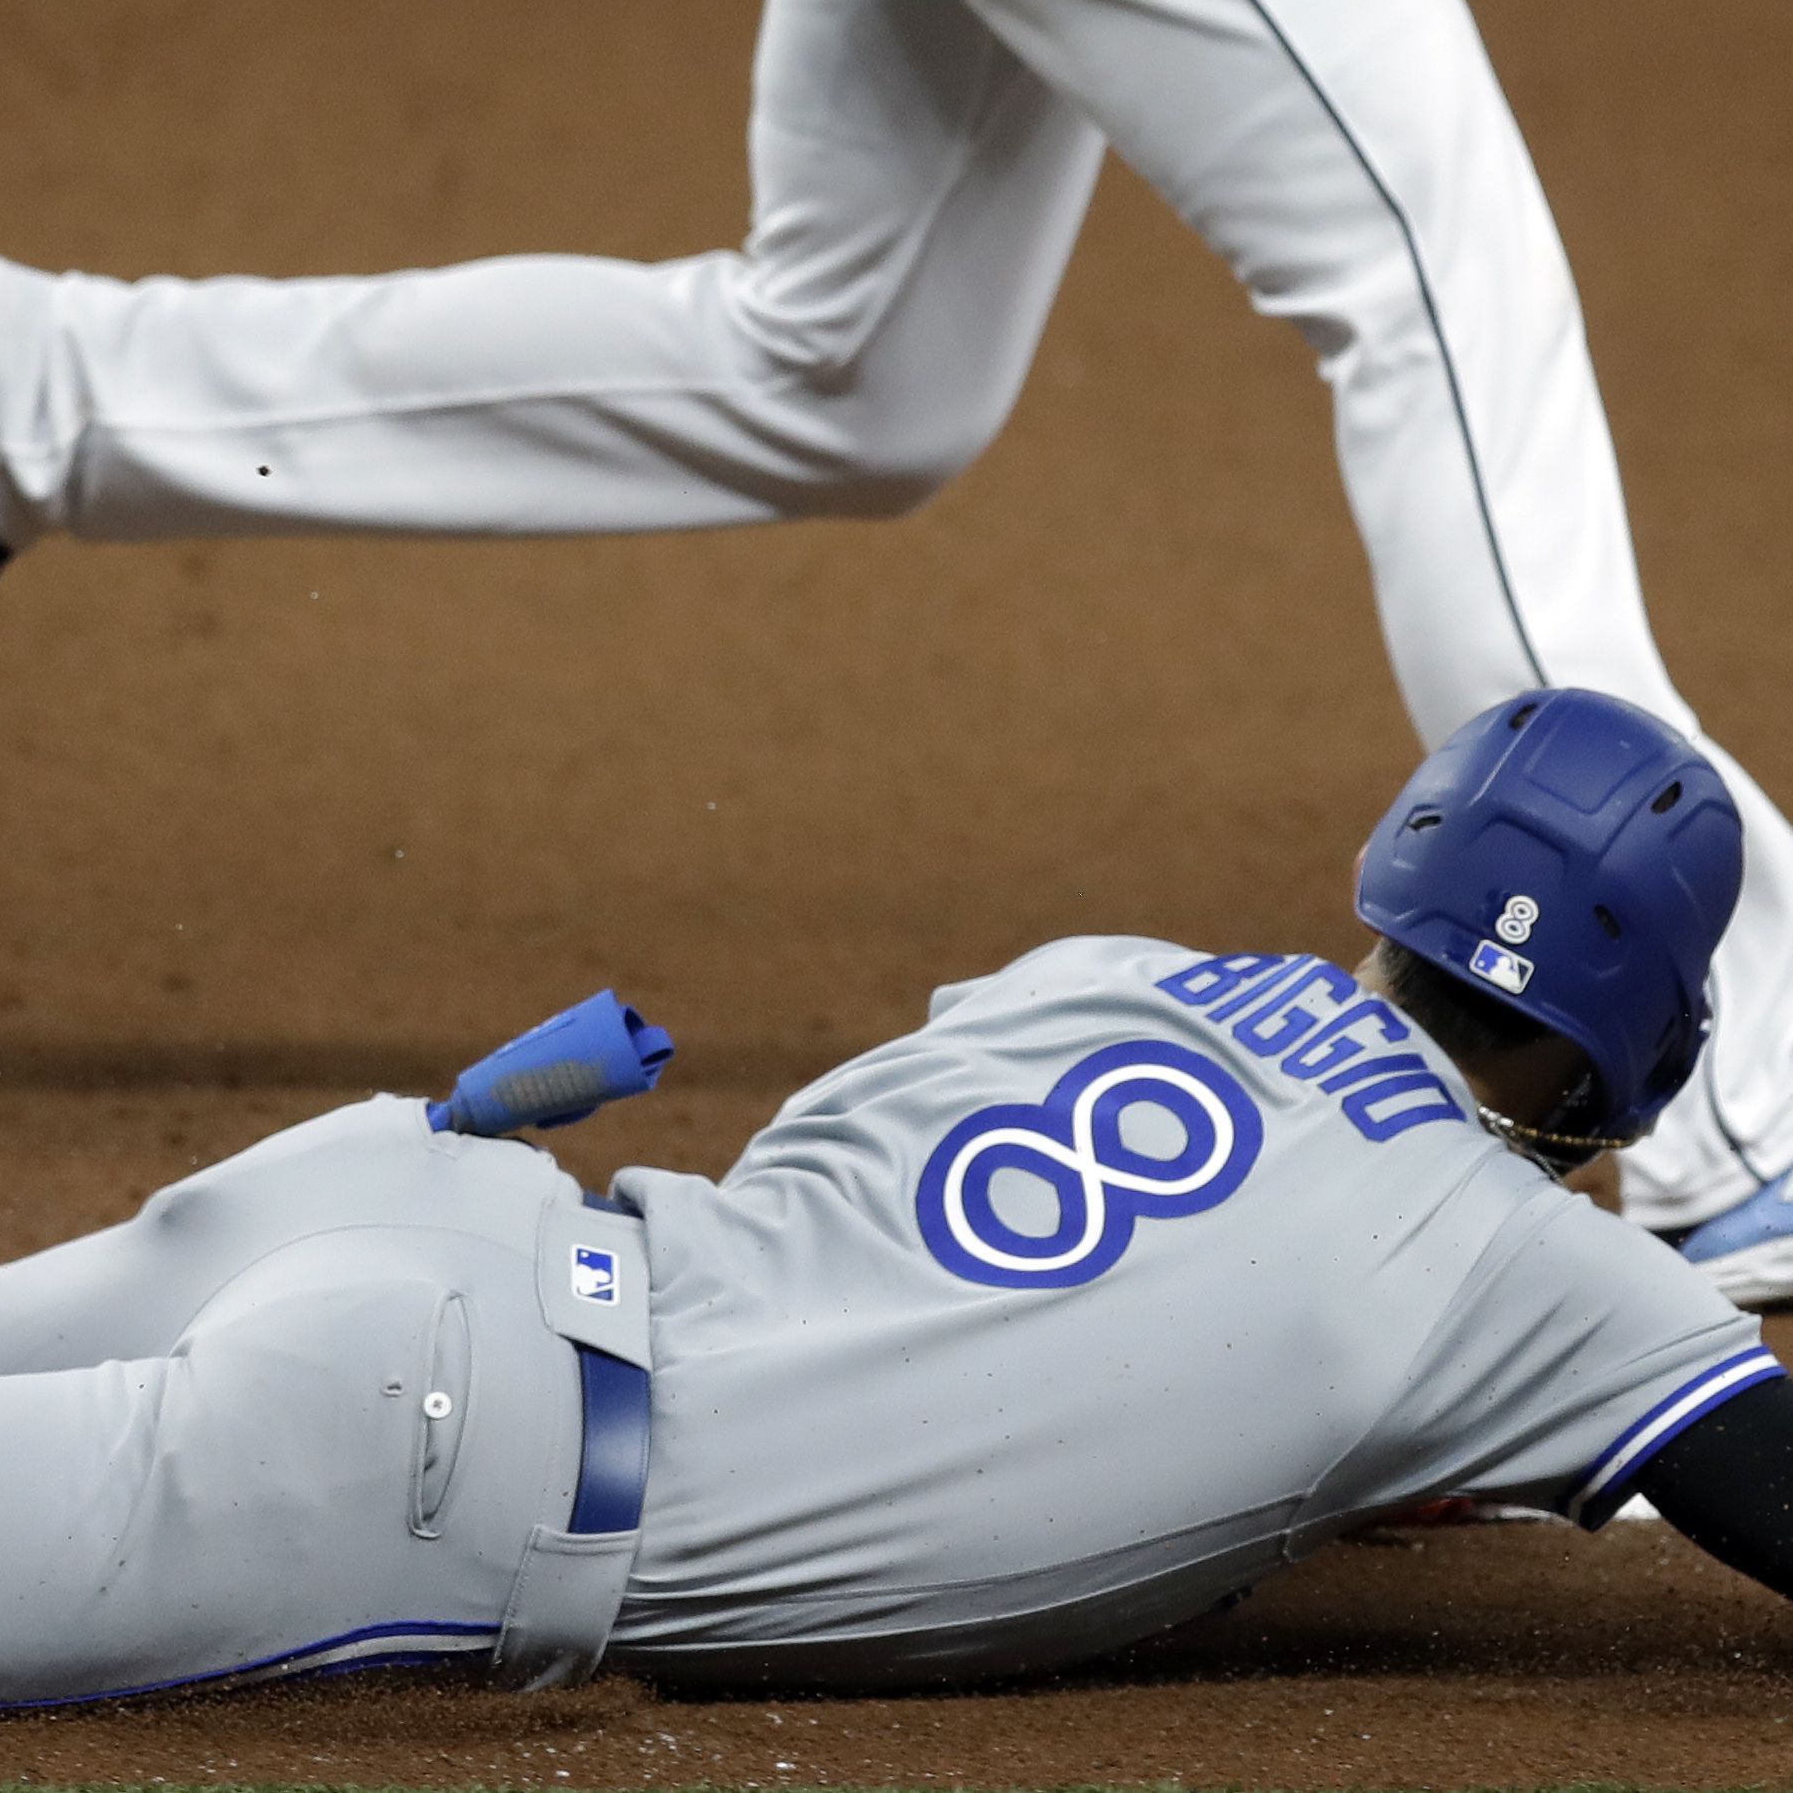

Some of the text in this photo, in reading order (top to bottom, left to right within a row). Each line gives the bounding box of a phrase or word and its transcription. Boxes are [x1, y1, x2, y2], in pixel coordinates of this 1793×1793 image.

[1495, 894, 1540, 945] 8
[1155, 952, 1468, 1143] BIGGIO
[915, 1039, 1264, 1289] 8
